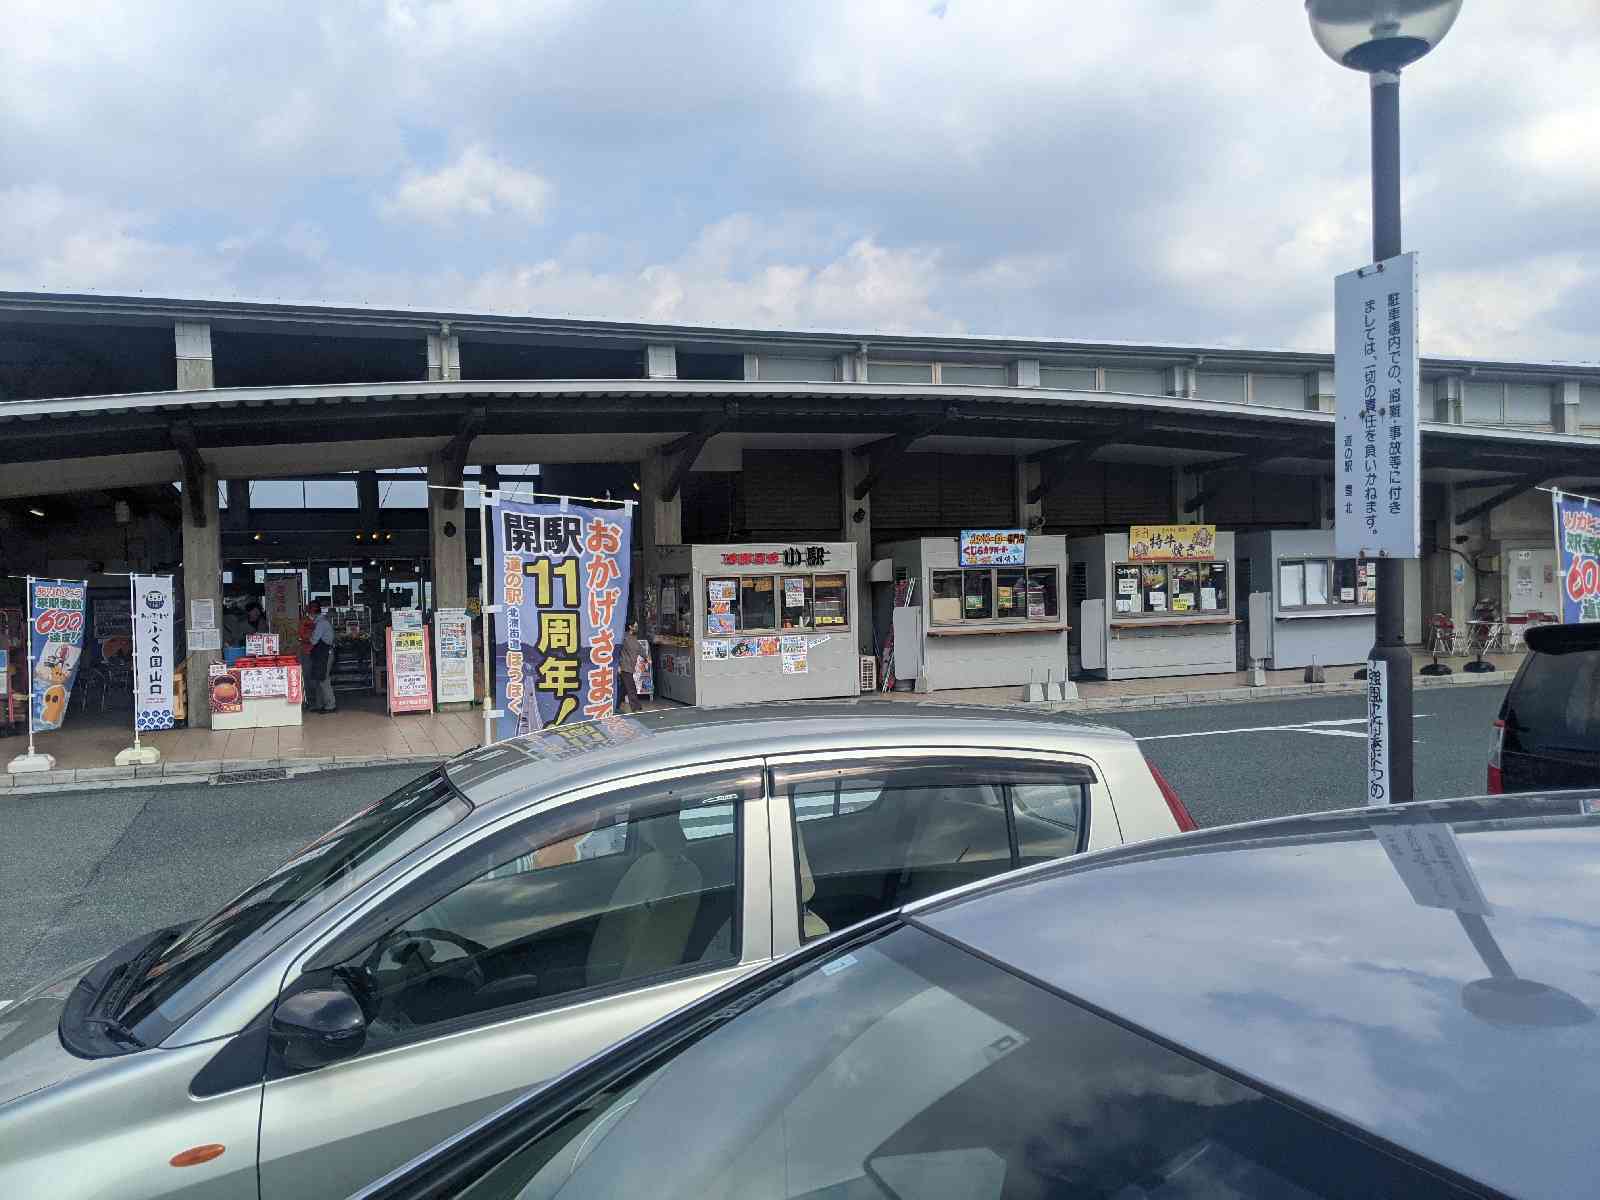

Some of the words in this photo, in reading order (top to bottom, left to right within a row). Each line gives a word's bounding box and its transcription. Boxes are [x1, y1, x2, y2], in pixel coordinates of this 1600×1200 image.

[1343, 435, 1353, 473] 道の駅
[502, 511, 584, 556] 開駅
[503, 555, 523, 604] 道の駅
[146, 621, 164, 695] ふくの国山口
[504, 651, 525, 715] ほうほく
